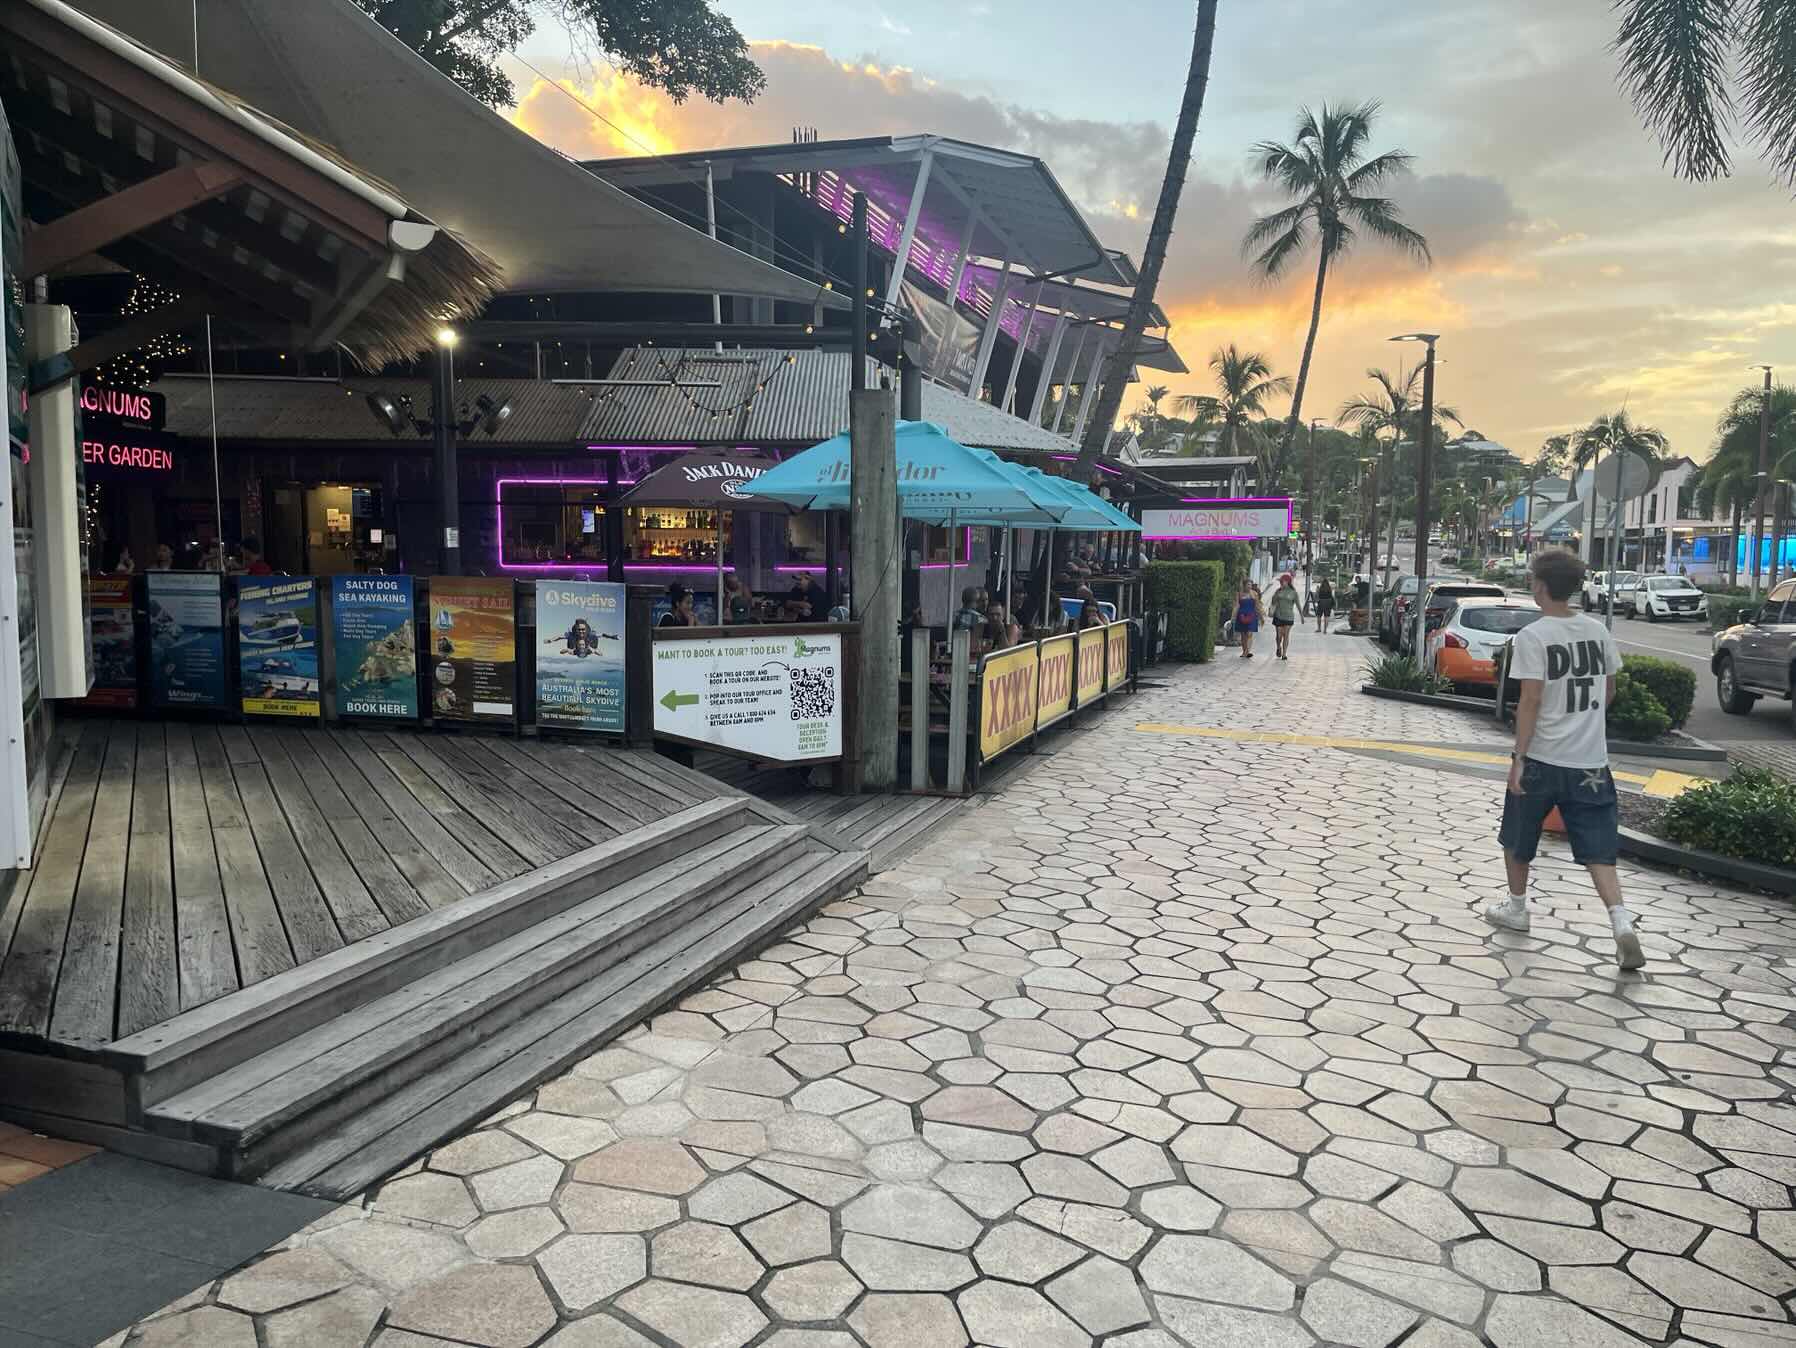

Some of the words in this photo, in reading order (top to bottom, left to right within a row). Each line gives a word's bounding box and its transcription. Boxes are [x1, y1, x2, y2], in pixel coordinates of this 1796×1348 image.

[80, 386, 151, 420] GNUMS
[82, 442, 104, 464] ER
[108, 444, 173, 470] GARDEN
[682, 464, 720, 482] JACK
[720, 462, 767, 480] DANI
[1168, 511, 1260, 527] MAGNUMS
[272, 580, 312, 595] CHARTERS
[346, 580, 374, 590] SALTY
[376, 581, 398, 590] DOG
[338, 593, 356, 602] SEA
[358, 594, 406, 604] KAYAKING
[560, 592, 616, 608] Skydive
[658, 650, 680, 660] WANT
[682, 650, 692, 658] TO
[694, 648, 715, 658] BOOK
[718, 648, 723, 656] A
[751, 646, 764, 655] TOO
[1546, 640, 1606, 680] DUN
[1039, 654, 1070, 710] XXXX
[542, 684, 592, 695] AUSTRALIA'S
[596, 688, 620, 697] MOST
[1566, 678, 1599, 713] IT.
[542, 694, 584, 704] BEAUTIFUL
[586, 697, 620, 706] SKYDIVE
[988, 664, 1033, 738] XXXX
[346, 702, 377, 713] BOOK
[378, 704, 408, 715] HERE
